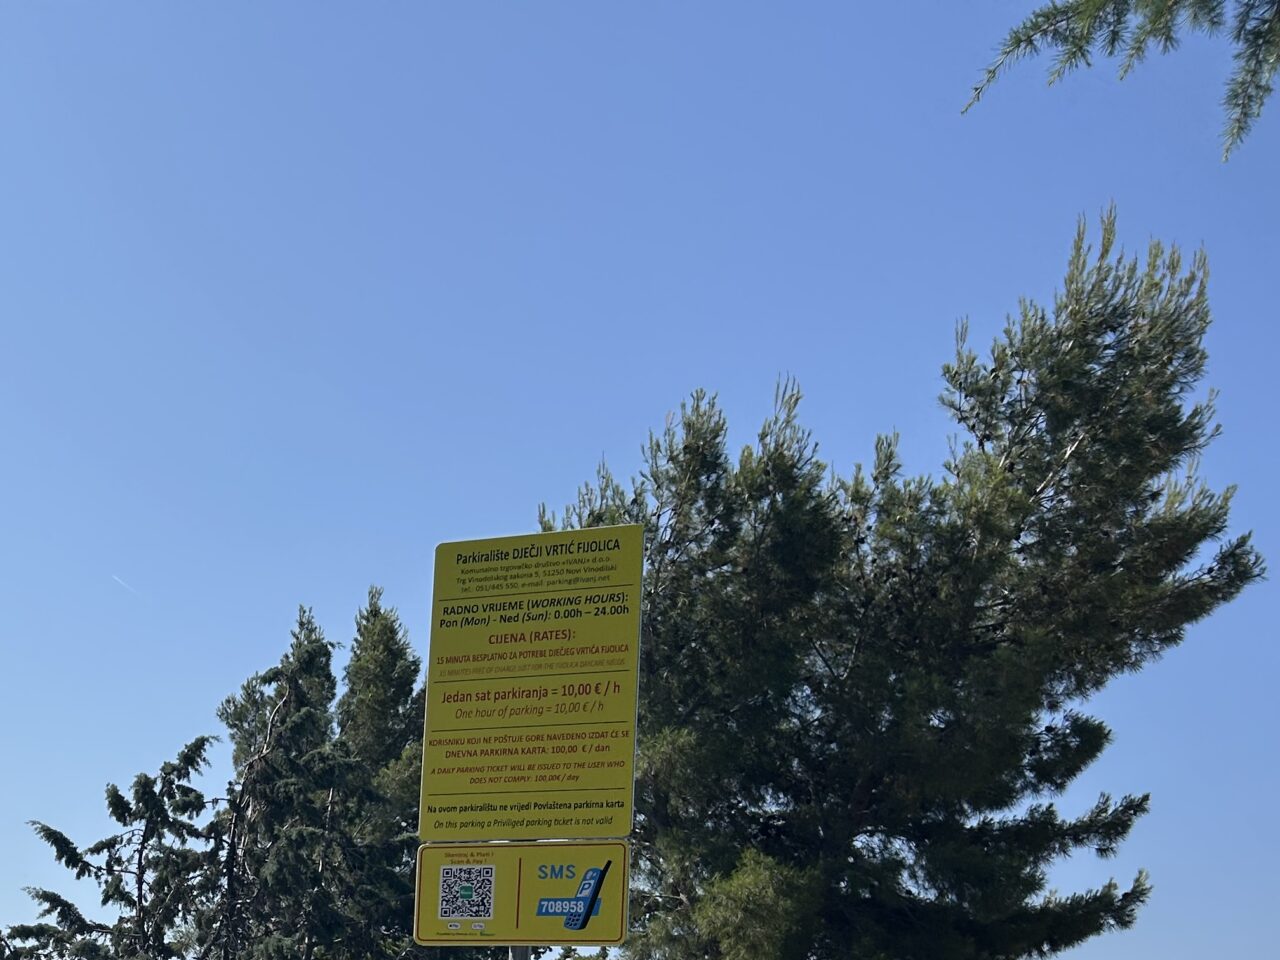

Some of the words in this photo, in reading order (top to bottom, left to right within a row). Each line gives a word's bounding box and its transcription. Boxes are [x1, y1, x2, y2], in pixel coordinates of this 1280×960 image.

[456, 549, 509, 564] Parkiralište
[512, 543, 542, 559] DJEČJI
[545, 539, 574, 556] VRTIĆ
[577, 538, 620, 553] FIJOLICA
[443, 604, 478, 615] RADNO
[481, 600, 524, 612] VRIJEME
[527, 595, 581, 610] (WORKING
[584, 591, 628, 604] HOURS):
[439, 618, 457, 628] Pon
[460, 615, 490, 628] (Mon)
[499, 612, 519, 623] Ned
[521, 610, 551, 623] (Sun):
[554, 608, 582, 619] 0.00h
[594, 604, 629, 616] 24.00h
[488, 632, 526, 644] CIJENA
[529, 628, 575, 643] (RATES):
[441, 690, 471, 703] Jedan
[474, 690, 490, 701] sat
[493, 686, 548, 702] parkiranja
[561, 683, 591, 697] 10,00
[594, 682, 601, 694] €
[603, 680, 610, 696] /
[613, 681, 620, 693] h
[455, 708, 472, 718] One
[475, 708, 495, 717] hour
[497, 705, 508, 718] of
[509, 705, 543, 717] parking
[553, 702, 580, 714] 10,00
[597, 700, 604, 711] h
[429, 738, 464, 746] KORISNIKU
[493, 734, 524, 743] POŠTUJE
[525, 734, 544, 742] GORE
[546, 732, 586, 740] NAVEDENO
[445, 749, 478, 758] DNEVNA
[479, 747, 519, 756] PARKIRNA
[551, 744, 577, 753] 100,00
[594, 744, 610, 752] dan
[427, 805, 436, 813] Na
[459, 803, 497, 813] parkiralištu
[509, 801, 531, 812] vrijedi
[533, 801, 571, 809] Povlaštena
[573, 800, 603, 810] parkirna
[605, 799, 624, 808] karta
[433, 820, 443, 829] On
[445, 820, 457, 828] this
[459, 820, 485, 829] parking
[525, 818, 552, 827] parking
[554, 817, 573, 825] ticket
[581, 817, 593, 825] not
[595, 815, 613, 824] valid
[538, 864, 576, 880] SMS
[579, 882, 592, 895] P
[540, 901, 584, 913] 708958
